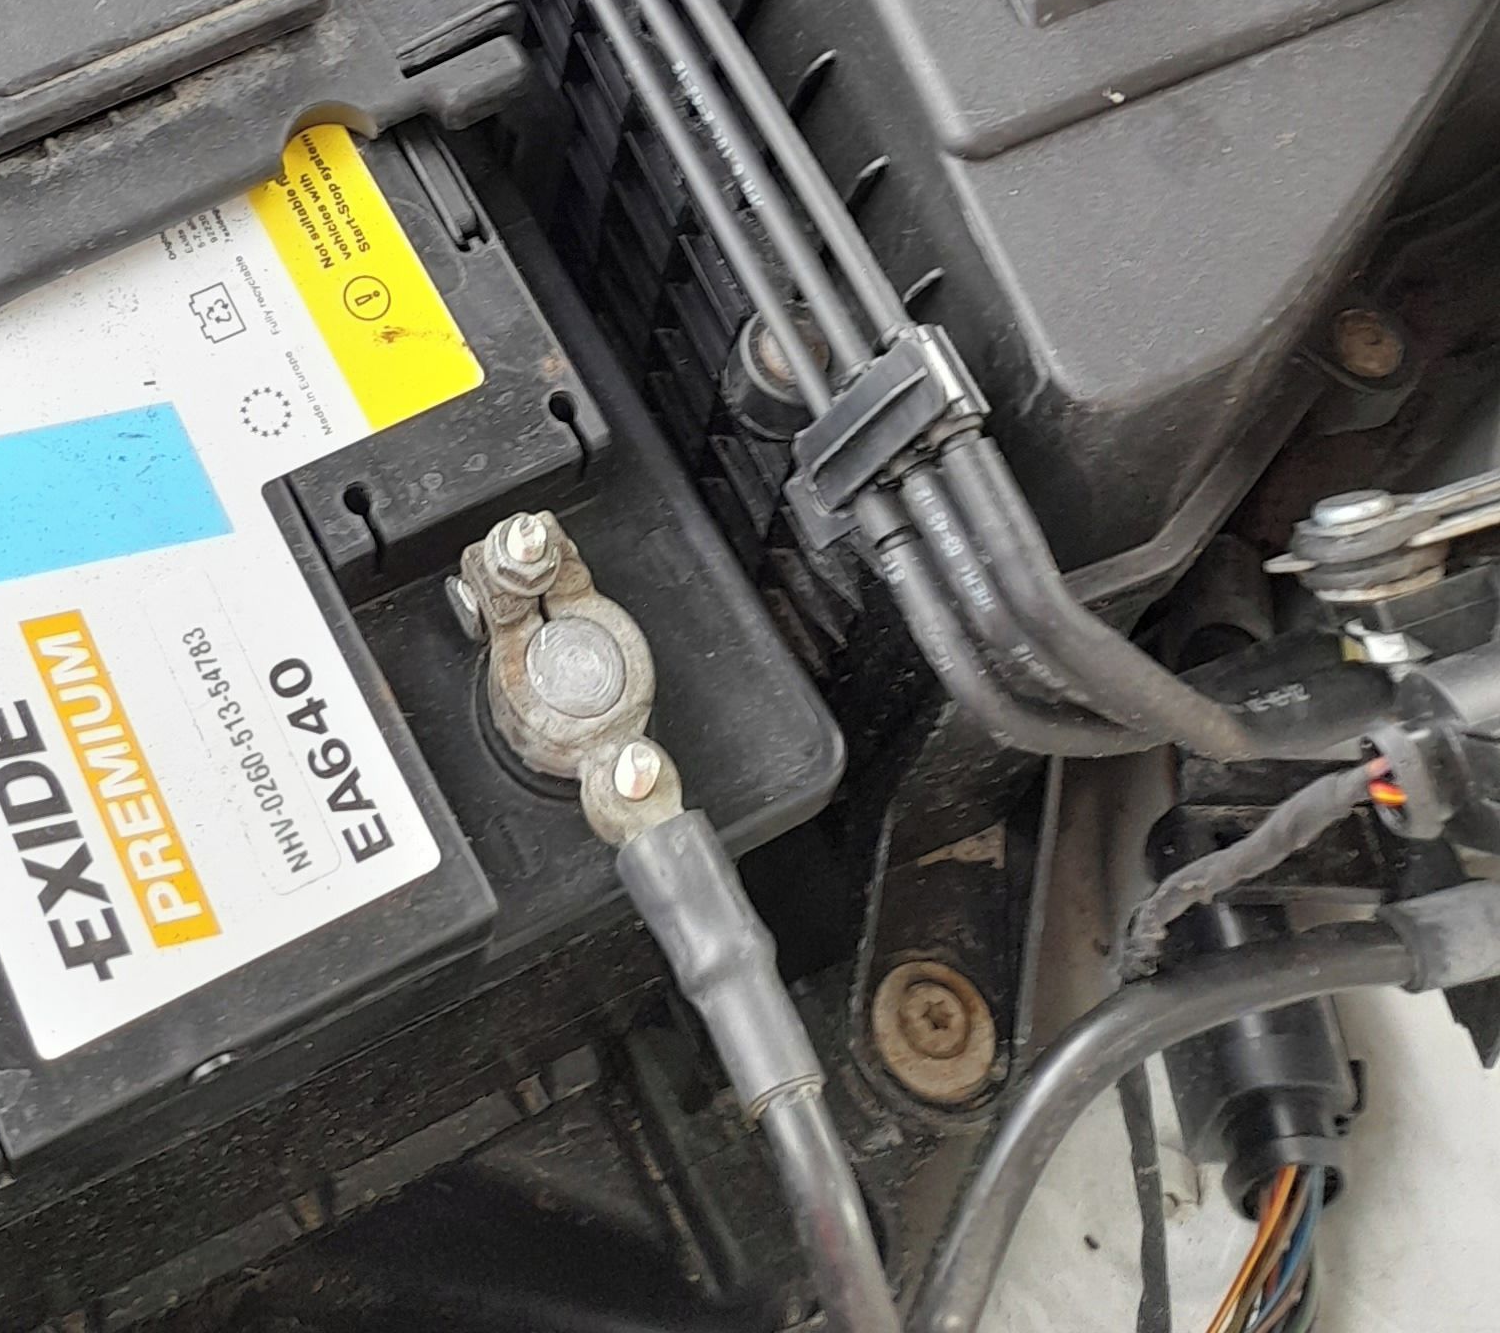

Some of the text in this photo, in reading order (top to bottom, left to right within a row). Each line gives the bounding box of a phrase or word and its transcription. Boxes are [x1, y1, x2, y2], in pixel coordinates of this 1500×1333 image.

[287, 188, 320, 241] suitable
[300, 173, 352, 261] vehicles with
[314, 243, 335, 269] Not
[328, 183, 371, 253] Start-Stop
[235, 255, 281, 336] Fully recyclable
[285, 351, 334, 435] Made in Europe
[35, 630, 203, 924] PREMIUM
[182, 627, 312, 874] NHV-0260-513-54783
[269, 658, 395, 863] EA640
